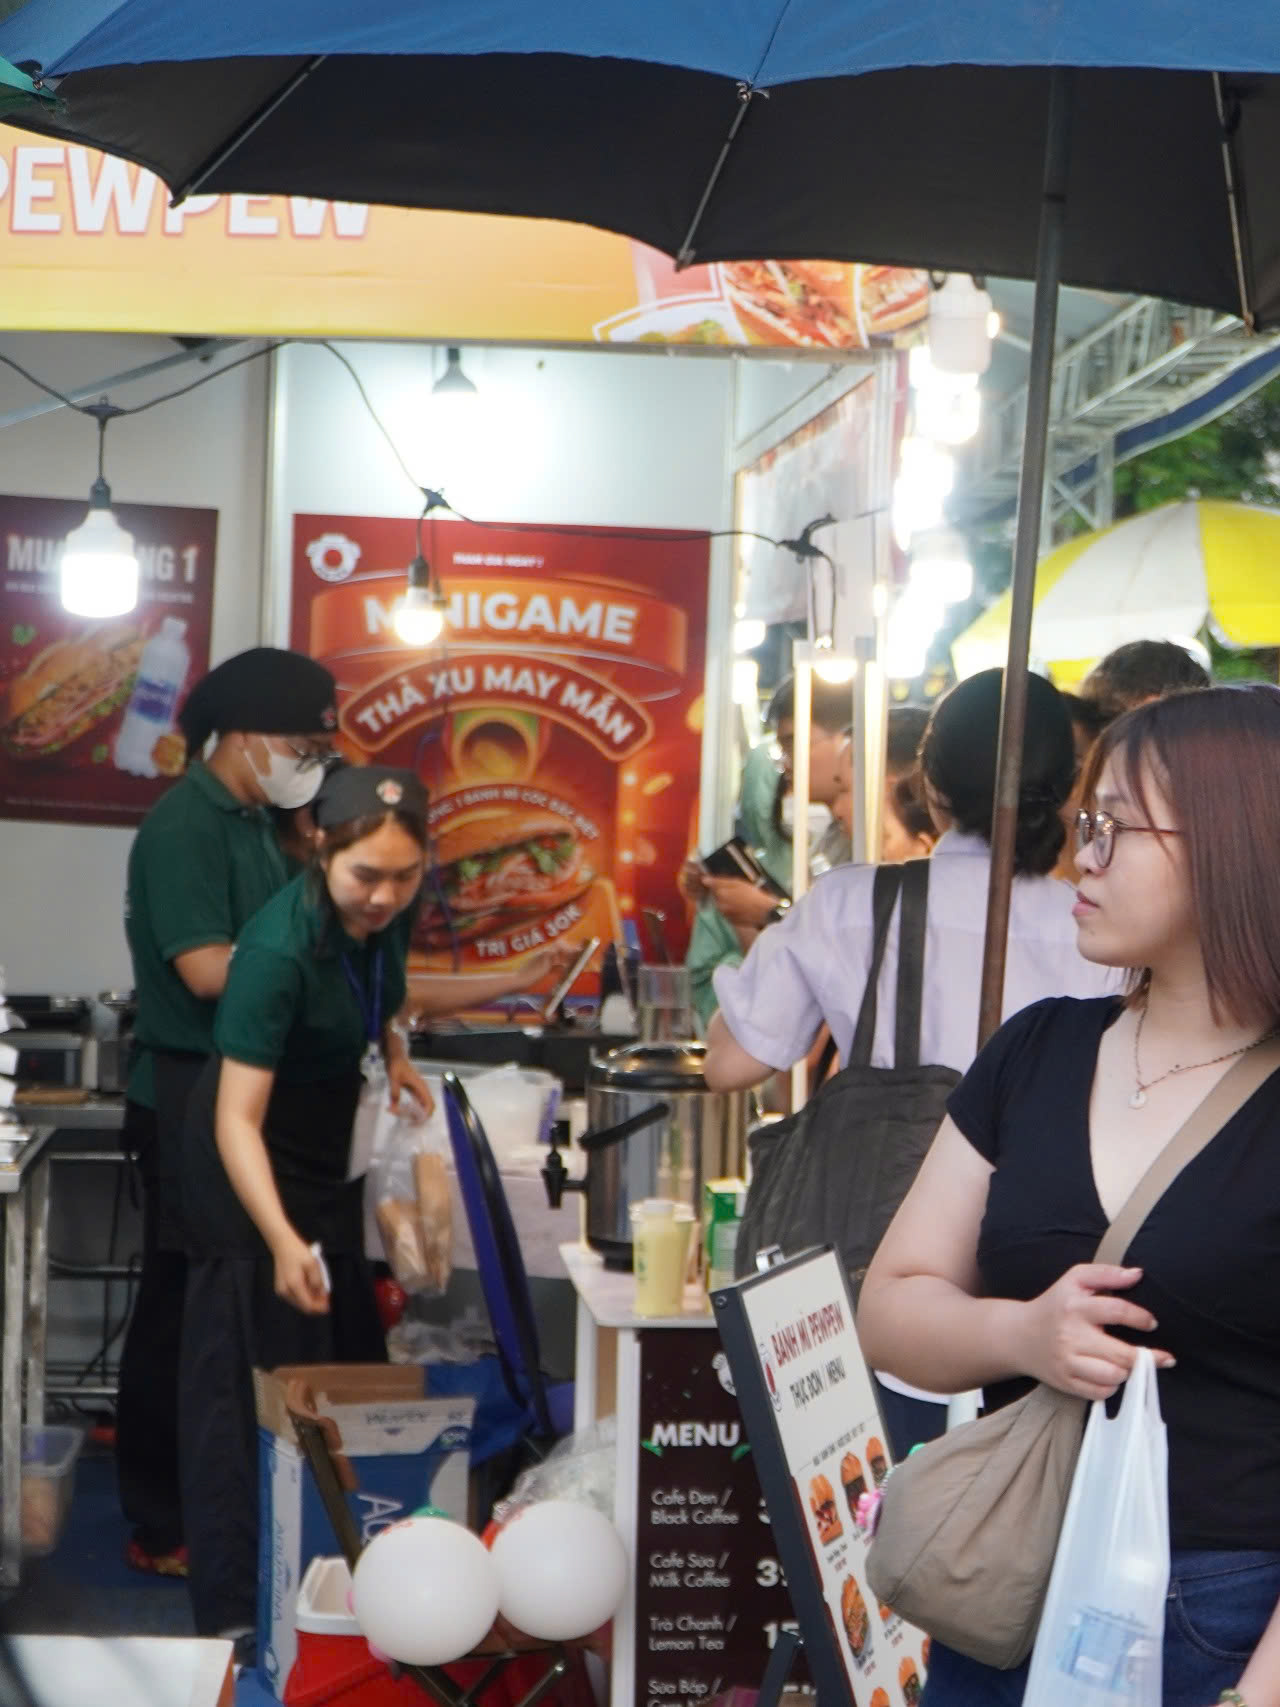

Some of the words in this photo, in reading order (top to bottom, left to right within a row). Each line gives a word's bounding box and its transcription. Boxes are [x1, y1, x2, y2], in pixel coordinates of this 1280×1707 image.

[0, 146, 368, 238] EWPEW
[182, 546, 199, 584] 1
[364, 592, 637, 645] MNIGAME
[428, 666, 475, 700] XU
[483, 665, 560, 700] MAY
[651, 1422, 740, 1448] MENU
[651, 1488, 687, 1506] Cafe
[650, 1508, 688, 1525] Black
[692, 1507, 740, 1525] Coffee
[650, 1551, 685, 1569] Cafe
[649, 1571, 682, 1588] Milk
[684, 1570, 731, 1588] Coffee
[756, 1558, 788, 1588] 3
[676, 1615, 723, 1632] Chanh
[649, 1636, 695, 1651] Lemon
[698, 1635, 725, 1651] Tea
